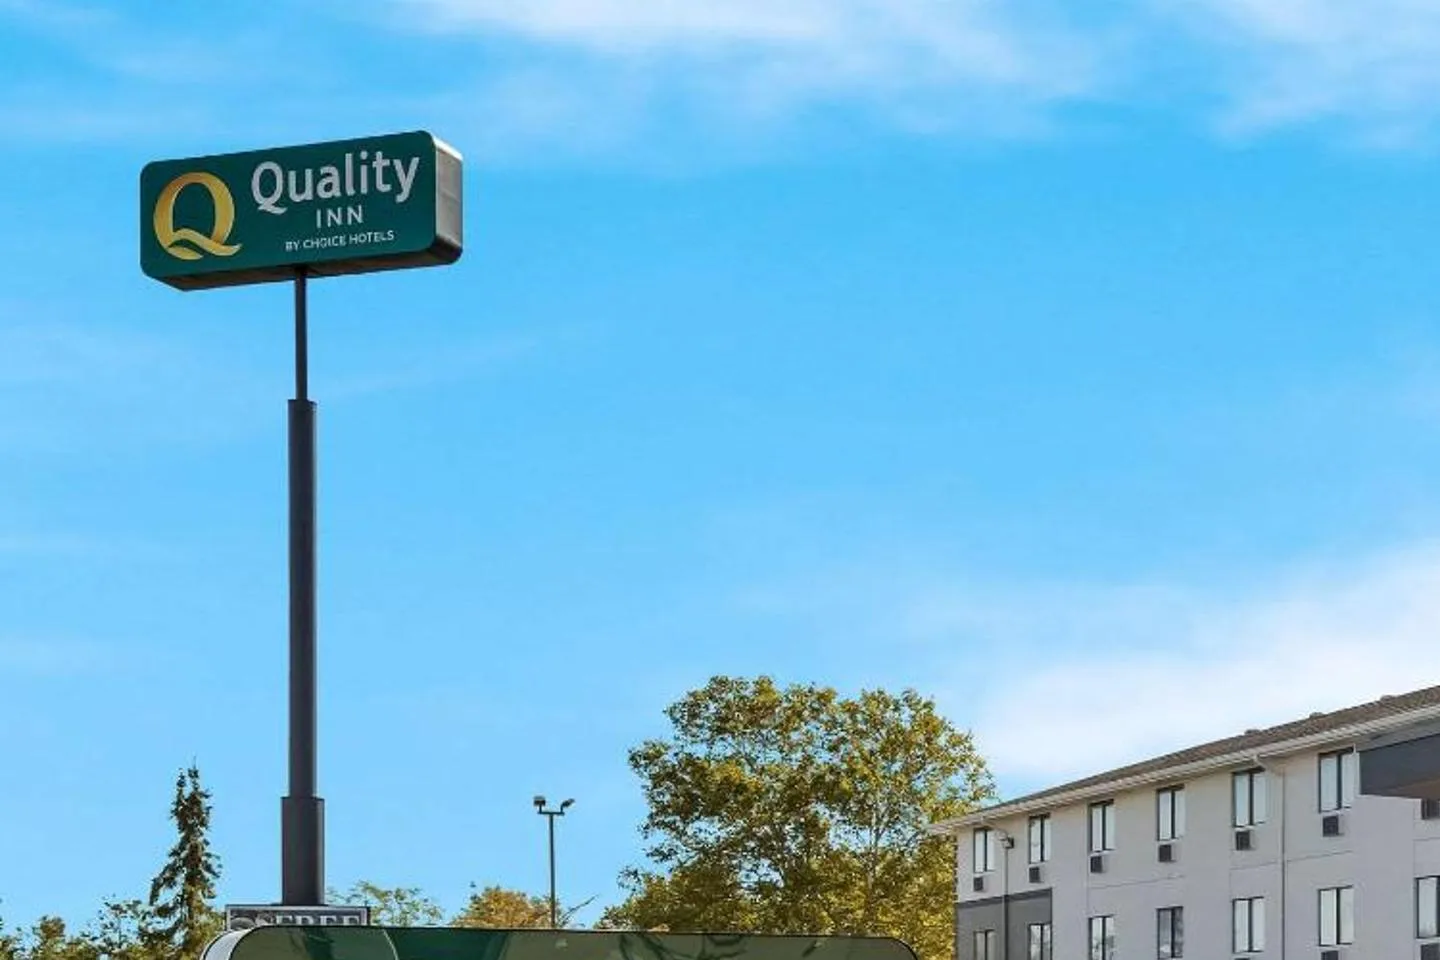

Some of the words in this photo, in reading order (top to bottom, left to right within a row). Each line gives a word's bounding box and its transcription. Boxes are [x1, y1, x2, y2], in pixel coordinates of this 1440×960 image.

[251, 149, 420, 215] Quality
[315, 204, 364, 229] INN
[284, 240, 300, 252] BY
[302, 235, 347, 249] CHOICE
[349, 229, 395, 245] HOTELS
